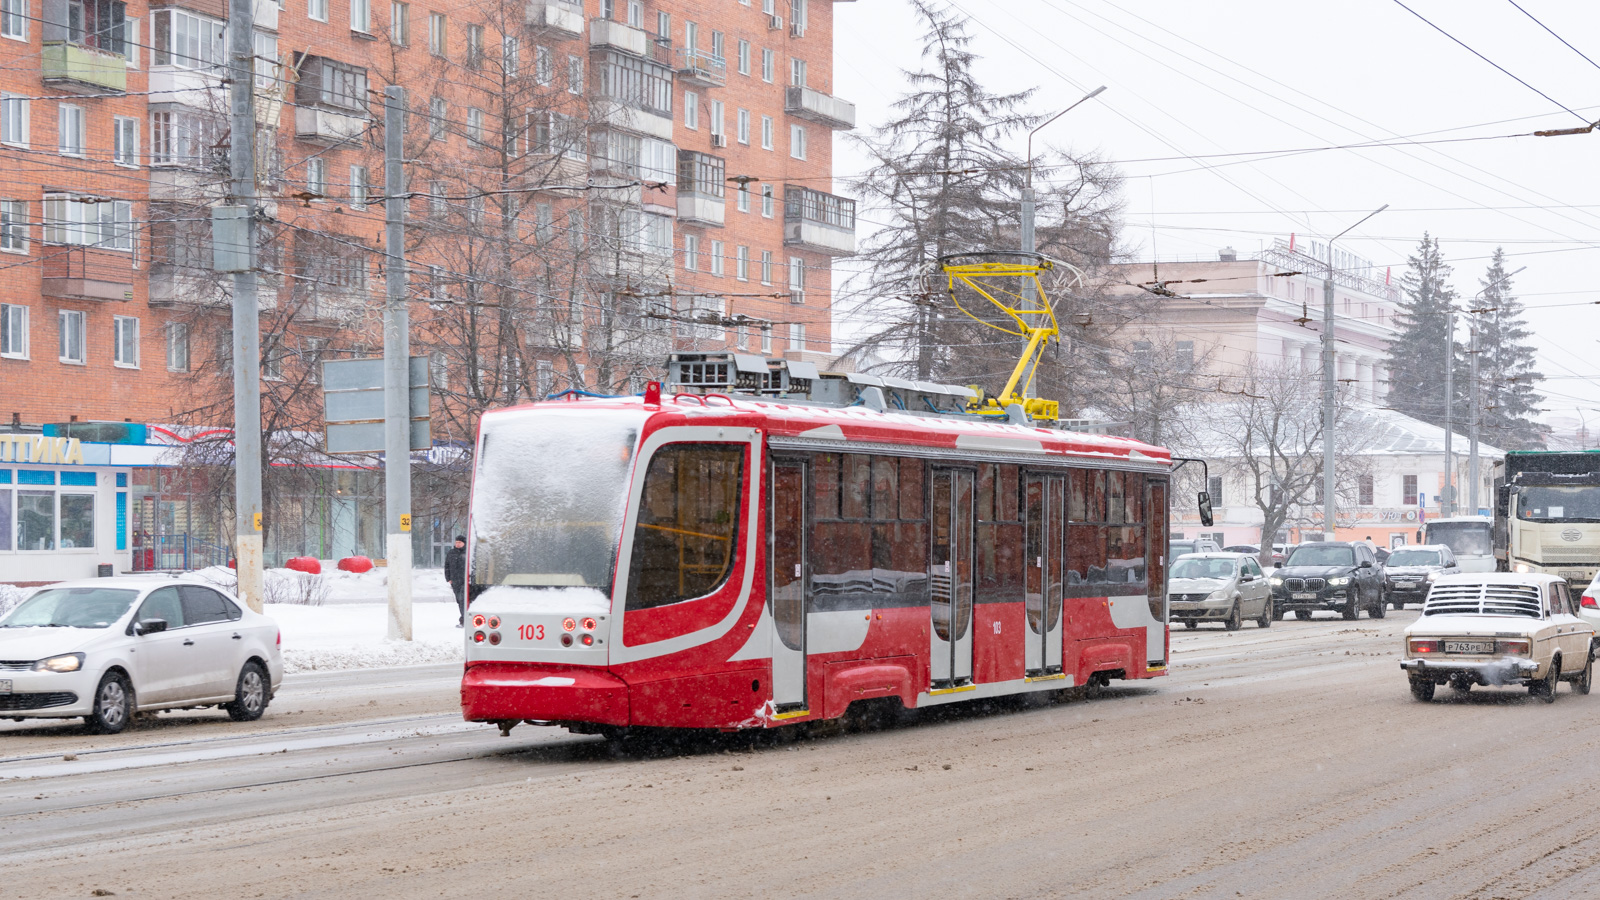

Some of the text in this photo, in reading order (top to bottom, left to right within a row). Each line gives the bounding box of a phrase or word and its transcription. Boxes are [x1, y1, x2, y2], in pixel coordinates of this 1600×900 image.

[401, 517, 411, 526] 32
[517, 624, 545, 641] 103
[993, 621, 1001, 635] 103
